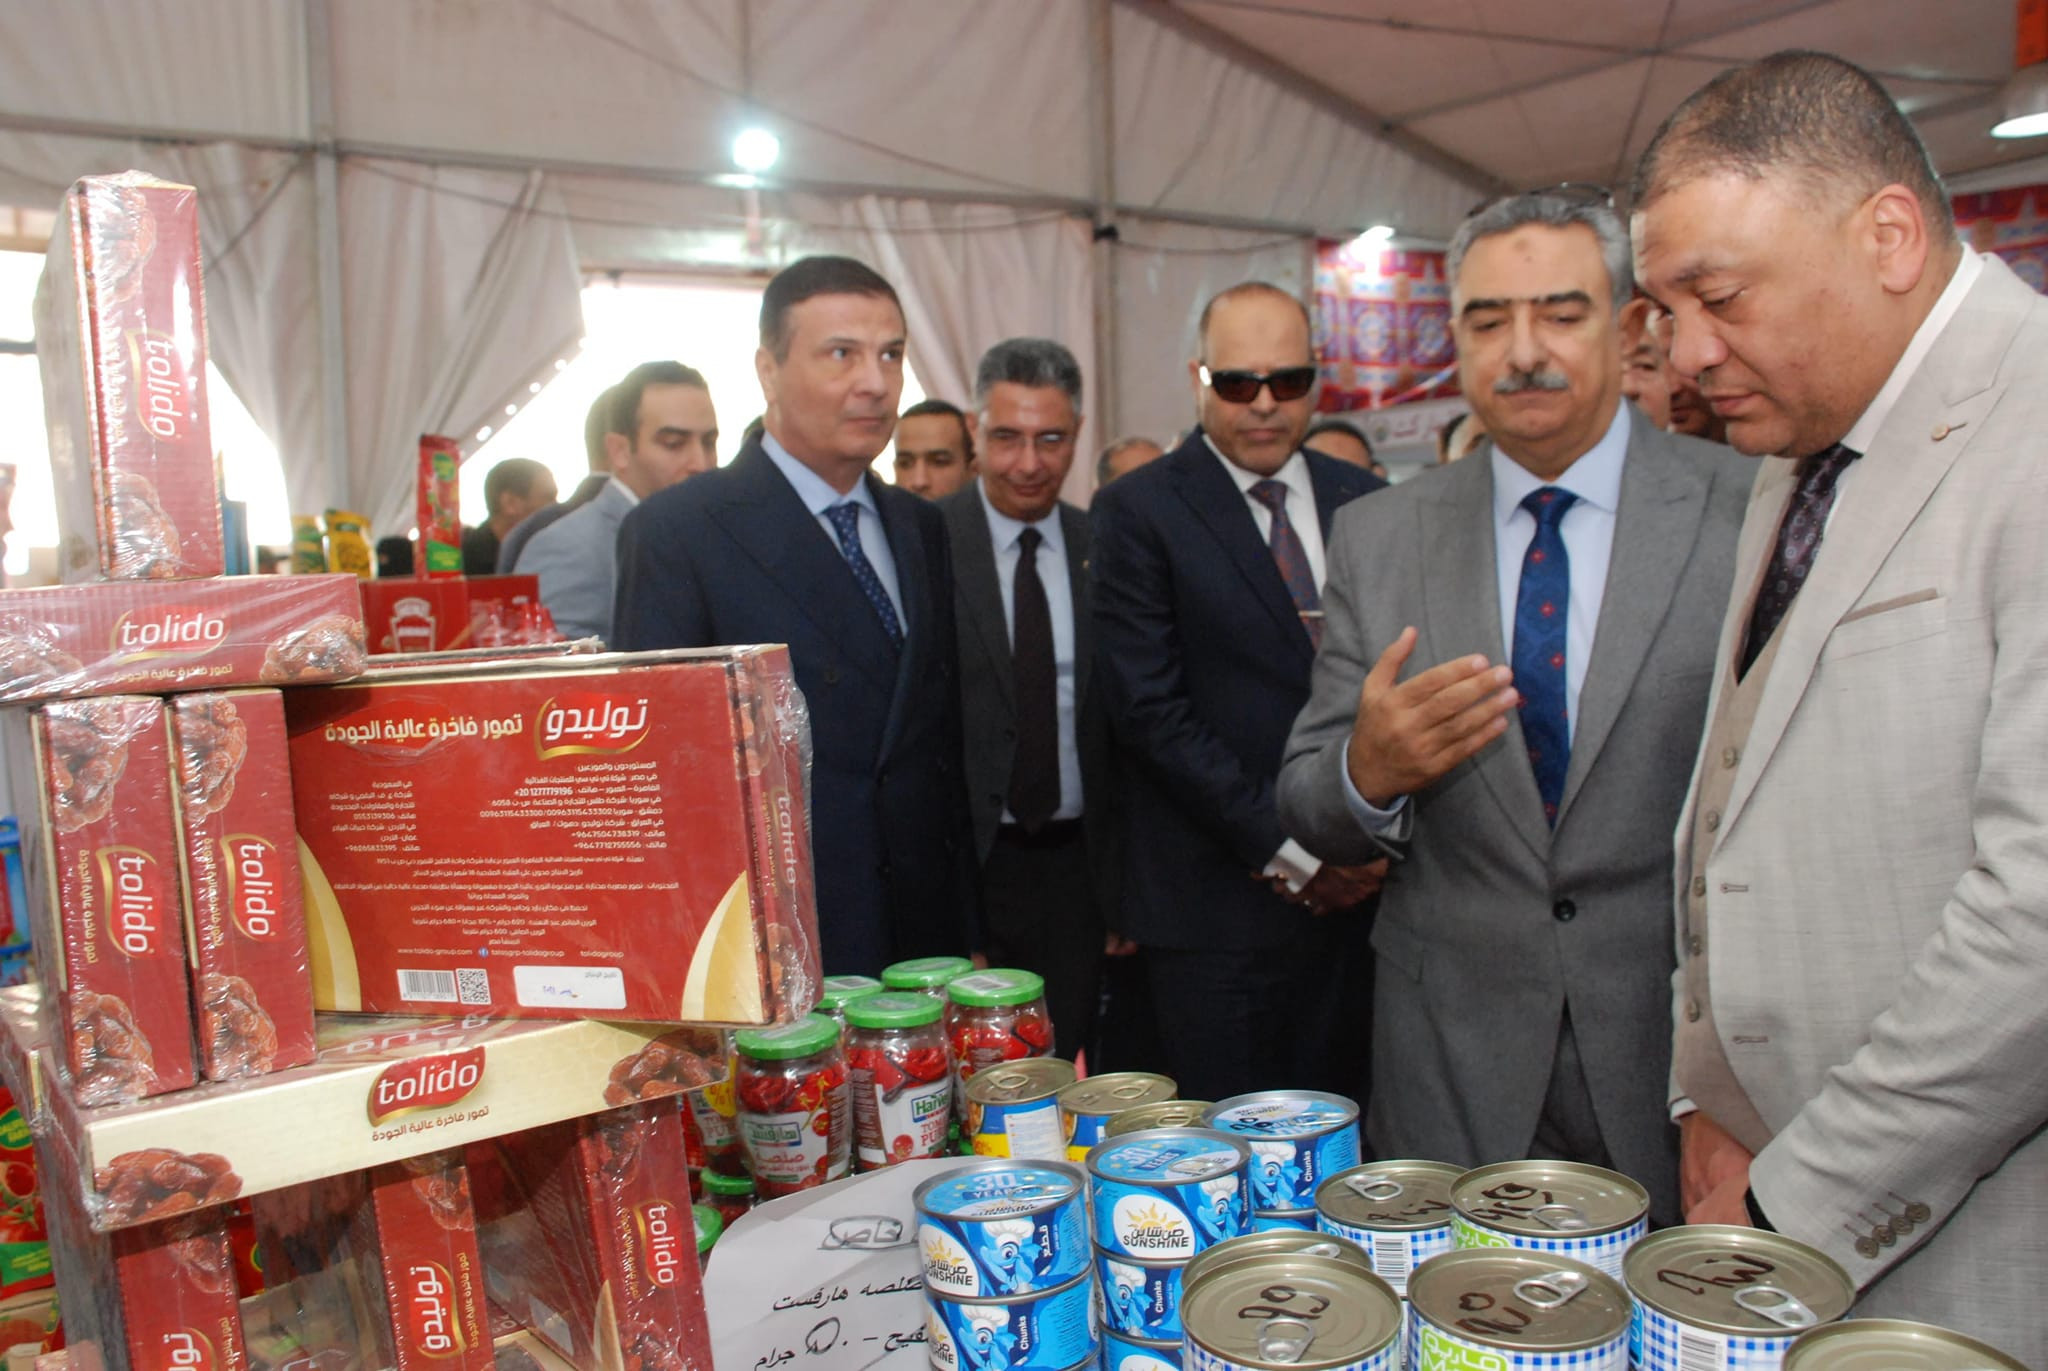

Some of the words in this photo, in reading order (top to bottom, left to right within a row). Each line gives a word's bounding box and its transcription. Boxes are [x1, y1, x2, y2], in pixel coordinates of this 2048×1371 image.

[145, 338, 182, 437] tolido
[121, 612, 225, 646] tolido
[151, 667, 178, 683] عالية
[210, 661, 233, 678] تمور
[384, 719, 427, 743] عالية
[428, 716, 478, 741] فاخرة
[481, 713, 524, 740] تمور
[545, 697, 649, 741] توليدو
[324, 720, 381, 744] الجودة
[633, 784, 661, 793] القاهرة
[77, 849, 92, 883] الجودة
[80, 885, 94, 908] عالية
[241, 843, 275, 935] tolido
[119, 856, 155, 953] tolido
[84, 911, 96, 938] فاخرة
[84, 941, 99, 964] تمور
[377, 1059, 478, 1105] tolido
[436, 1112, 465, 1128] فاخرة
[466, 1105, 490, 1122] تمور
[371, 1124, 407, 1142] الجودة
[409, 1118, 434, 1135] عالية
[1303, 1150, 1314, 1183] Chunks
[972, 1172, 1018, 1191] 30
[650, 1205, 678, 1283] tolido
[1039, 1224, 1053, 1258] قطع
[1123, 1234, 1190, 1249] SUNSHINE
[1131, 1226, 1162, 1240] شاين
[1162, 1228, 1185, 1241] صن
[457, 1252, 469, 1271] تمور
[462, 1272, 472, 1297] فاخرة
[1154, 1279, 1164, 1313] Chunks
[412, 1264, 449, 1350] توليدو
[465, 1297, 475, 1319] عالية
[772, 1286, 849, 1312] هارفست
[468, 1319, 479, 1347] الجودة
[1019, 1315, 1030, 1350] Chunks
[754, 1347, 796, 1371] جرام
